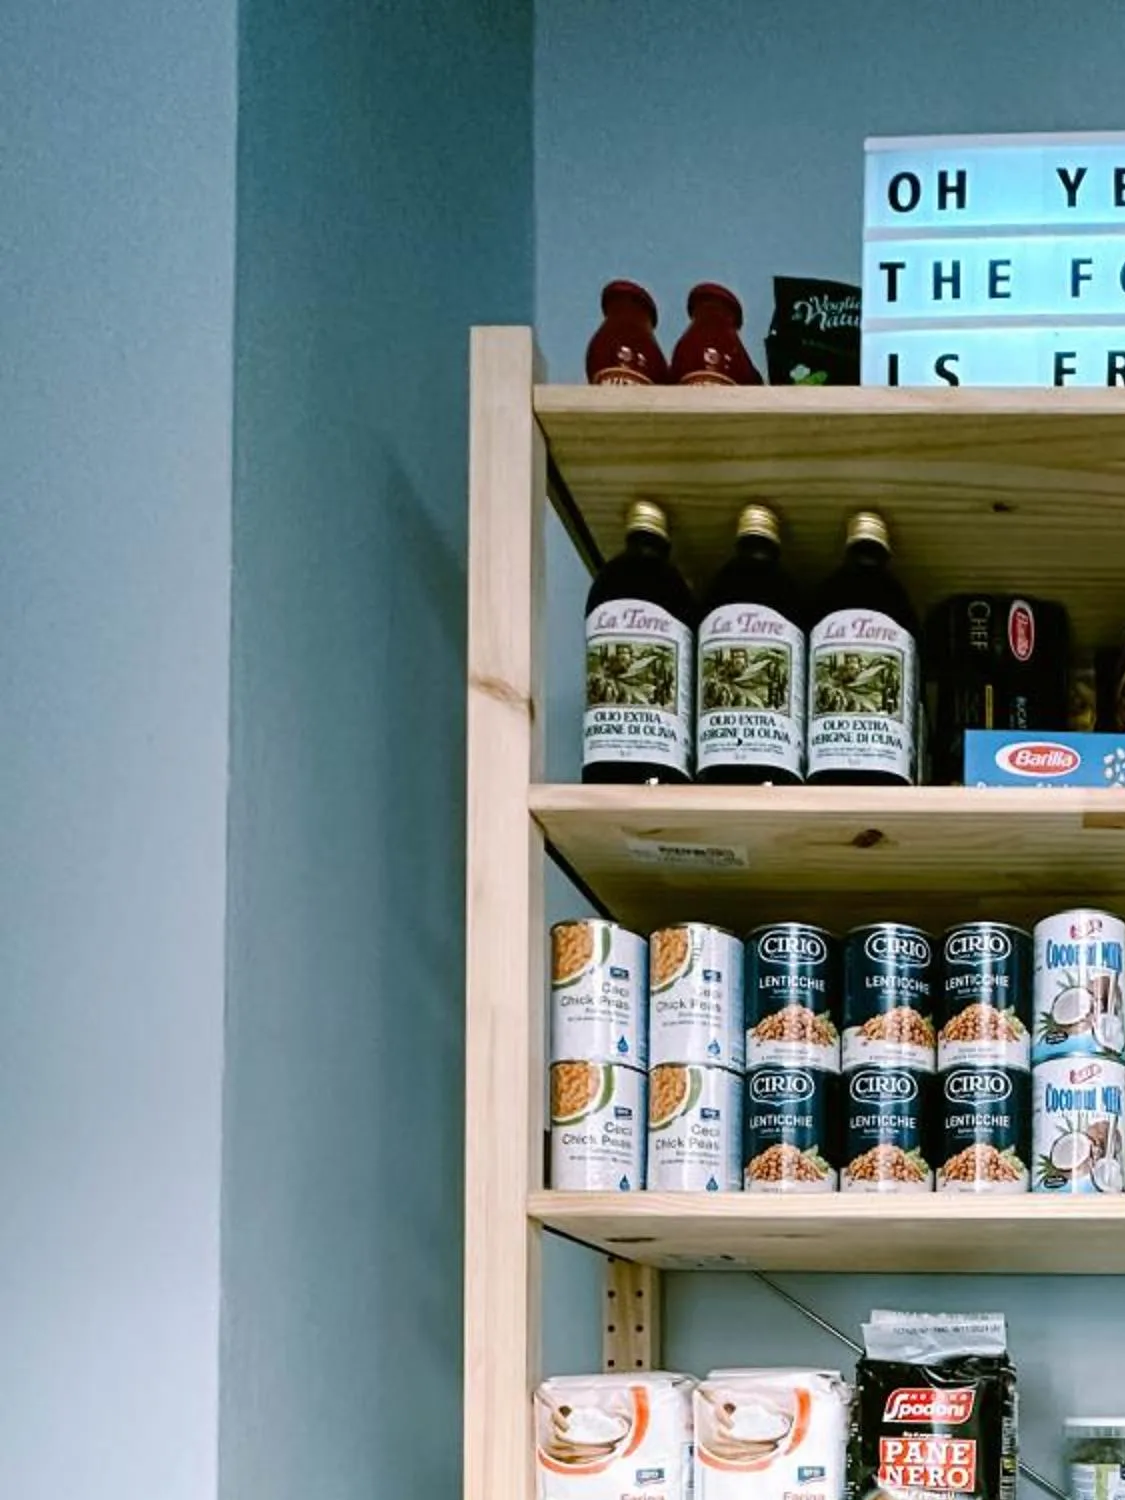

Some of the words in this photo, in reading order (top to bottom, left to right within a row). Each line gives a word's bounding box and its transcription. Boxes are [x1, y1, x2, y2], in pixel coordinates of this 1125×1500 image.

[888, 170, 967, 212] OH
[880, 259, 1011, 302] THE
[888, 353, 961, 386] IS
[594, 611, 616, 629] La
[623, 608, 669, 632] Torre
[711, 616, 731, 634] La
[738, 612, 784, 635] Torre
[824, 621, 845, 638] La
[852, 617, 897, 641] Torre
[595, 711, 620, 722] OLIO
[624, 711, 661, 723] EXTRA
[709, 715, 736, 726] OLIO
[739, 715, 776, 726] EXTRA
[823, 719, 850, 731] OLIO
[853, 720, 889, 731] EXTRA
[627, 725, 641, 734] DI
[743, 727, 755, 738] DI
[857, 732, 869, 744] DI
[1016, 750, 1073, 768] Barilla
[764, 937, 821, 956] CIRIO
[872, 937, 926, 959] CIRIO
[949, 936, 1004, 954] CIRIO
[753, 1076, 807, 1094] CIRIO
[856, 1076, 911, 1093] CIRIO
[950, 1076, 1005, 1093] CIRIO
[749, 1114, 813, 1129] LENTICCHIE
[850, 1115, 917, 1129] LENTICCHIE
[945, 1114, 1011, 1129] LENTICCHIE
[885, 1393, 965, 1421] Spodoni
[885, 1440, 970, 1465] PANE
[884, 1464, 969, 1487] NERO
